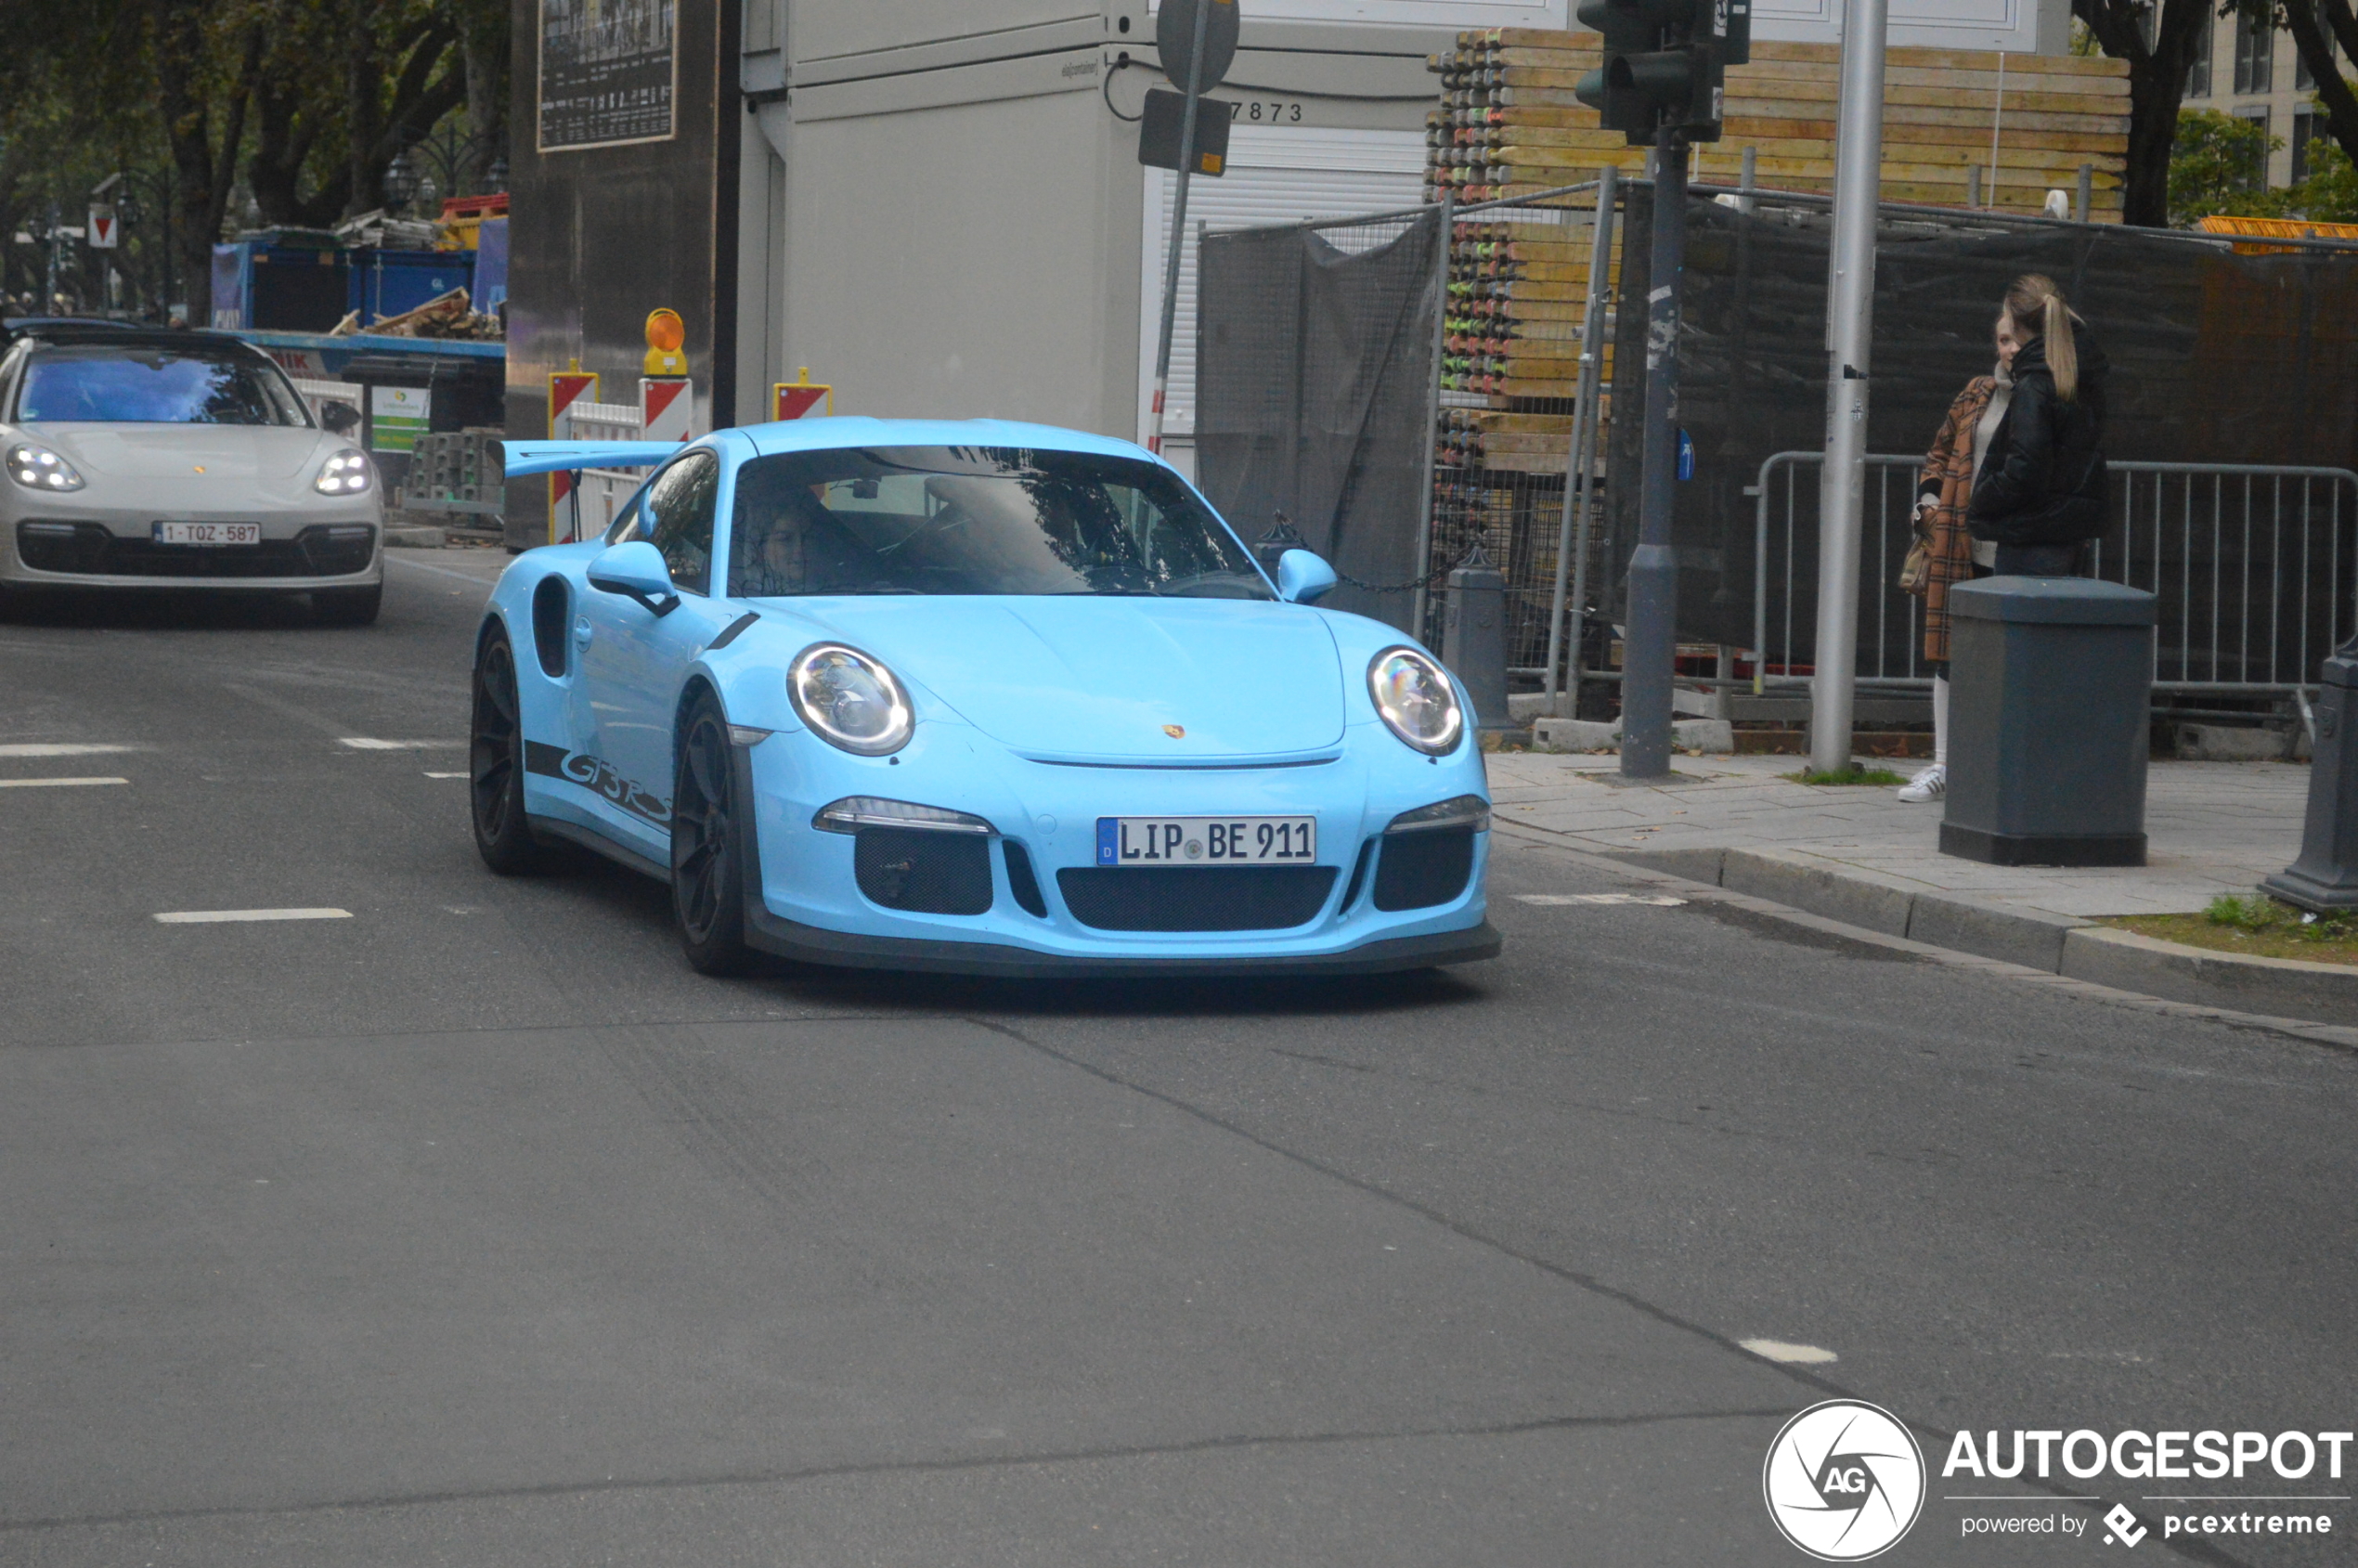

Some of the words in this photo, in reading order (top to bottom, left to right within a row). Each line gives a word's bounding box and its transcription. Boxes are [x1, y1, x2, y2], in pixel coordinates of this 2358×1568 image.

[1103, 847, 1112, 858] D
[1121, 823, 1183, 859] LIP
[1209, 823, 1248, 859] BE
[1257, 823, 1312, 858] 911
